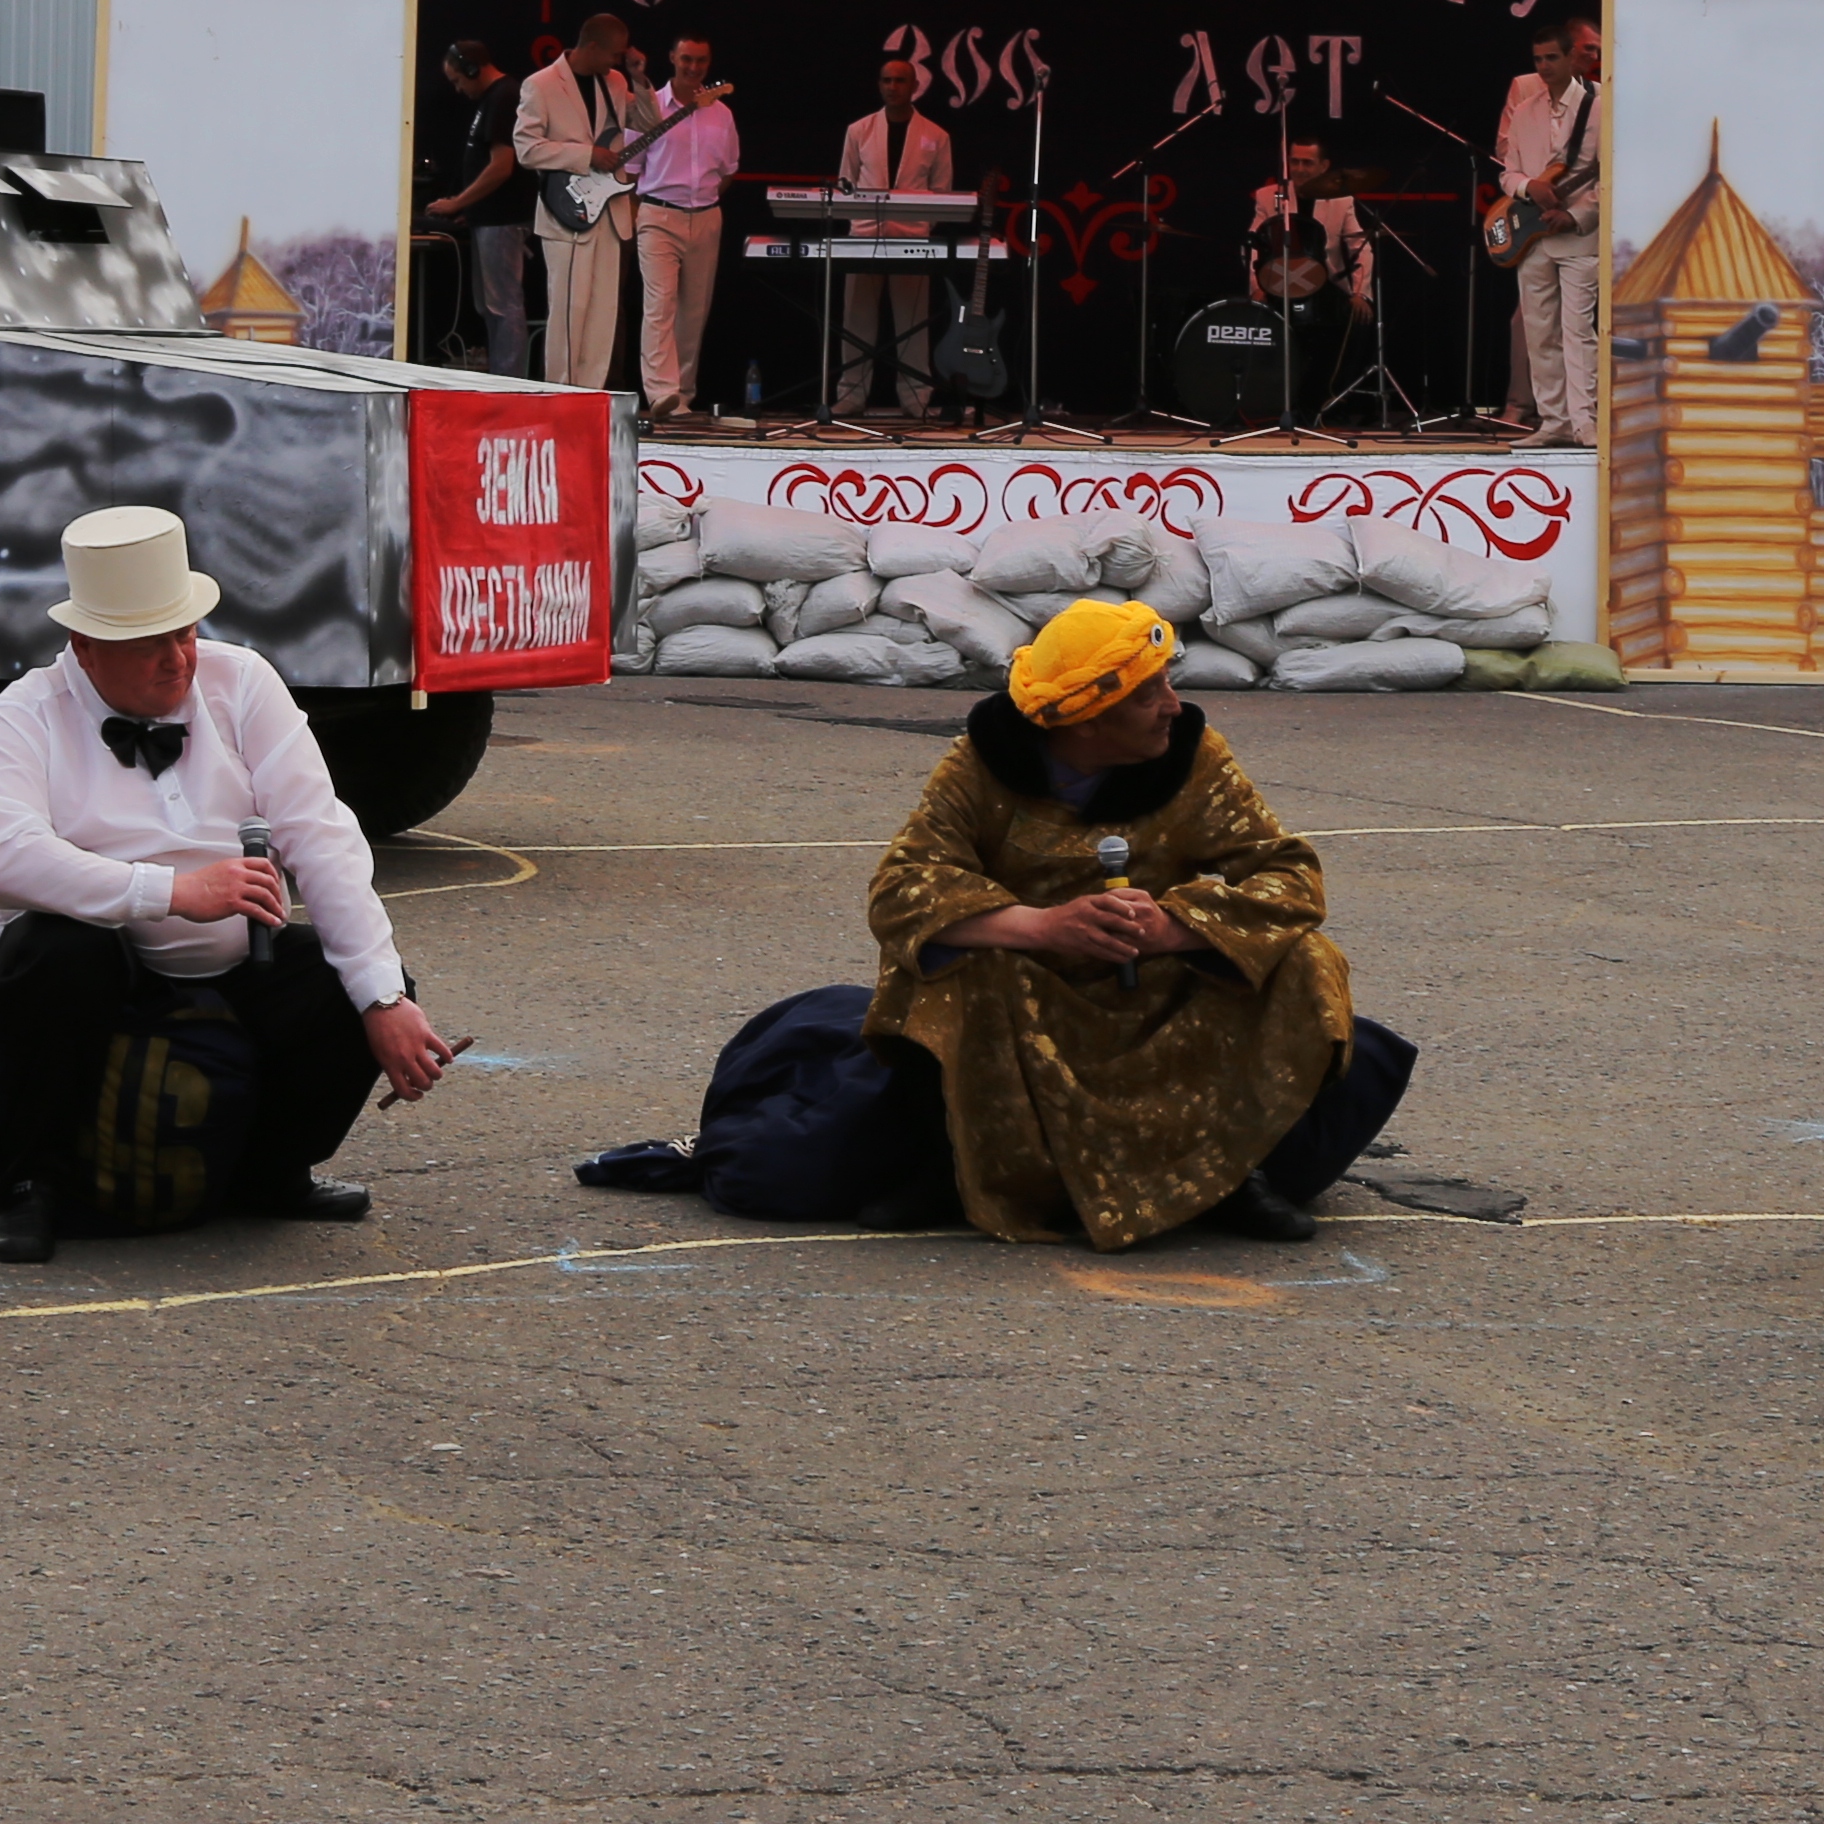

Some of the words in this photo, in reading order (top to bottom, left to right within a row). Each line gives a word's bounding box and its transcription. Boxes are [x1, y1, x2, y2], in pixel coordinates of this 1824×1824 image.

[1172, 30, 1362, 119] ЛЕТ
[476, 437, 559, 525] ЗЕМЛЯ
[439, 561, 591, 655] КРЕСТЬЯНАМ
